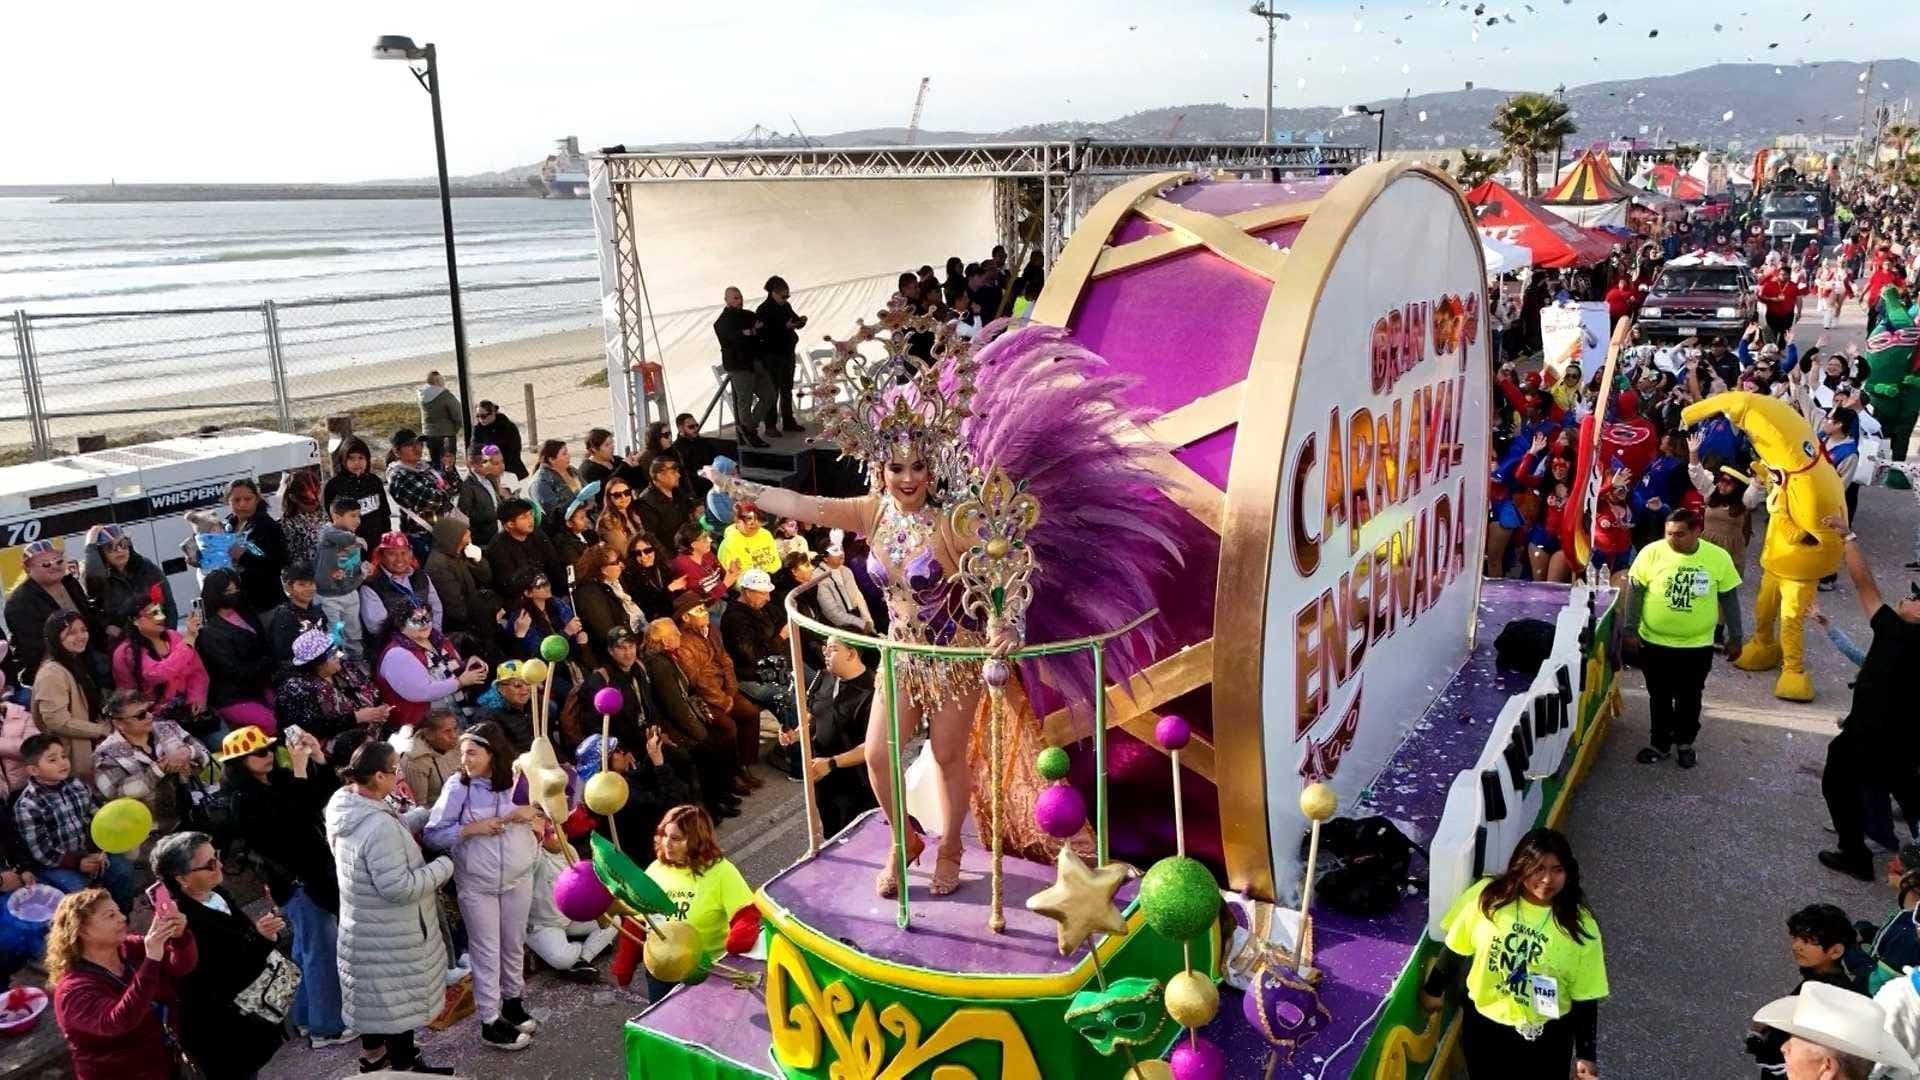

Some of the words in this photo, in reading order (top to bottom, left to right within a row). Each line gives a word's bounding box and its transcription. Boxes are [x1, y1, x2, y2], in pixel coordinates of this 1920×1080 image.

[1369, 300, 1427, 396] GRAN
[1289, 376, 1465, 578] CARNAVAL
[7, 520, 41, 546] 70
[1292, 477, 1466, 743] ENSENADA
[1505, 933, 1543, 964] CAR
